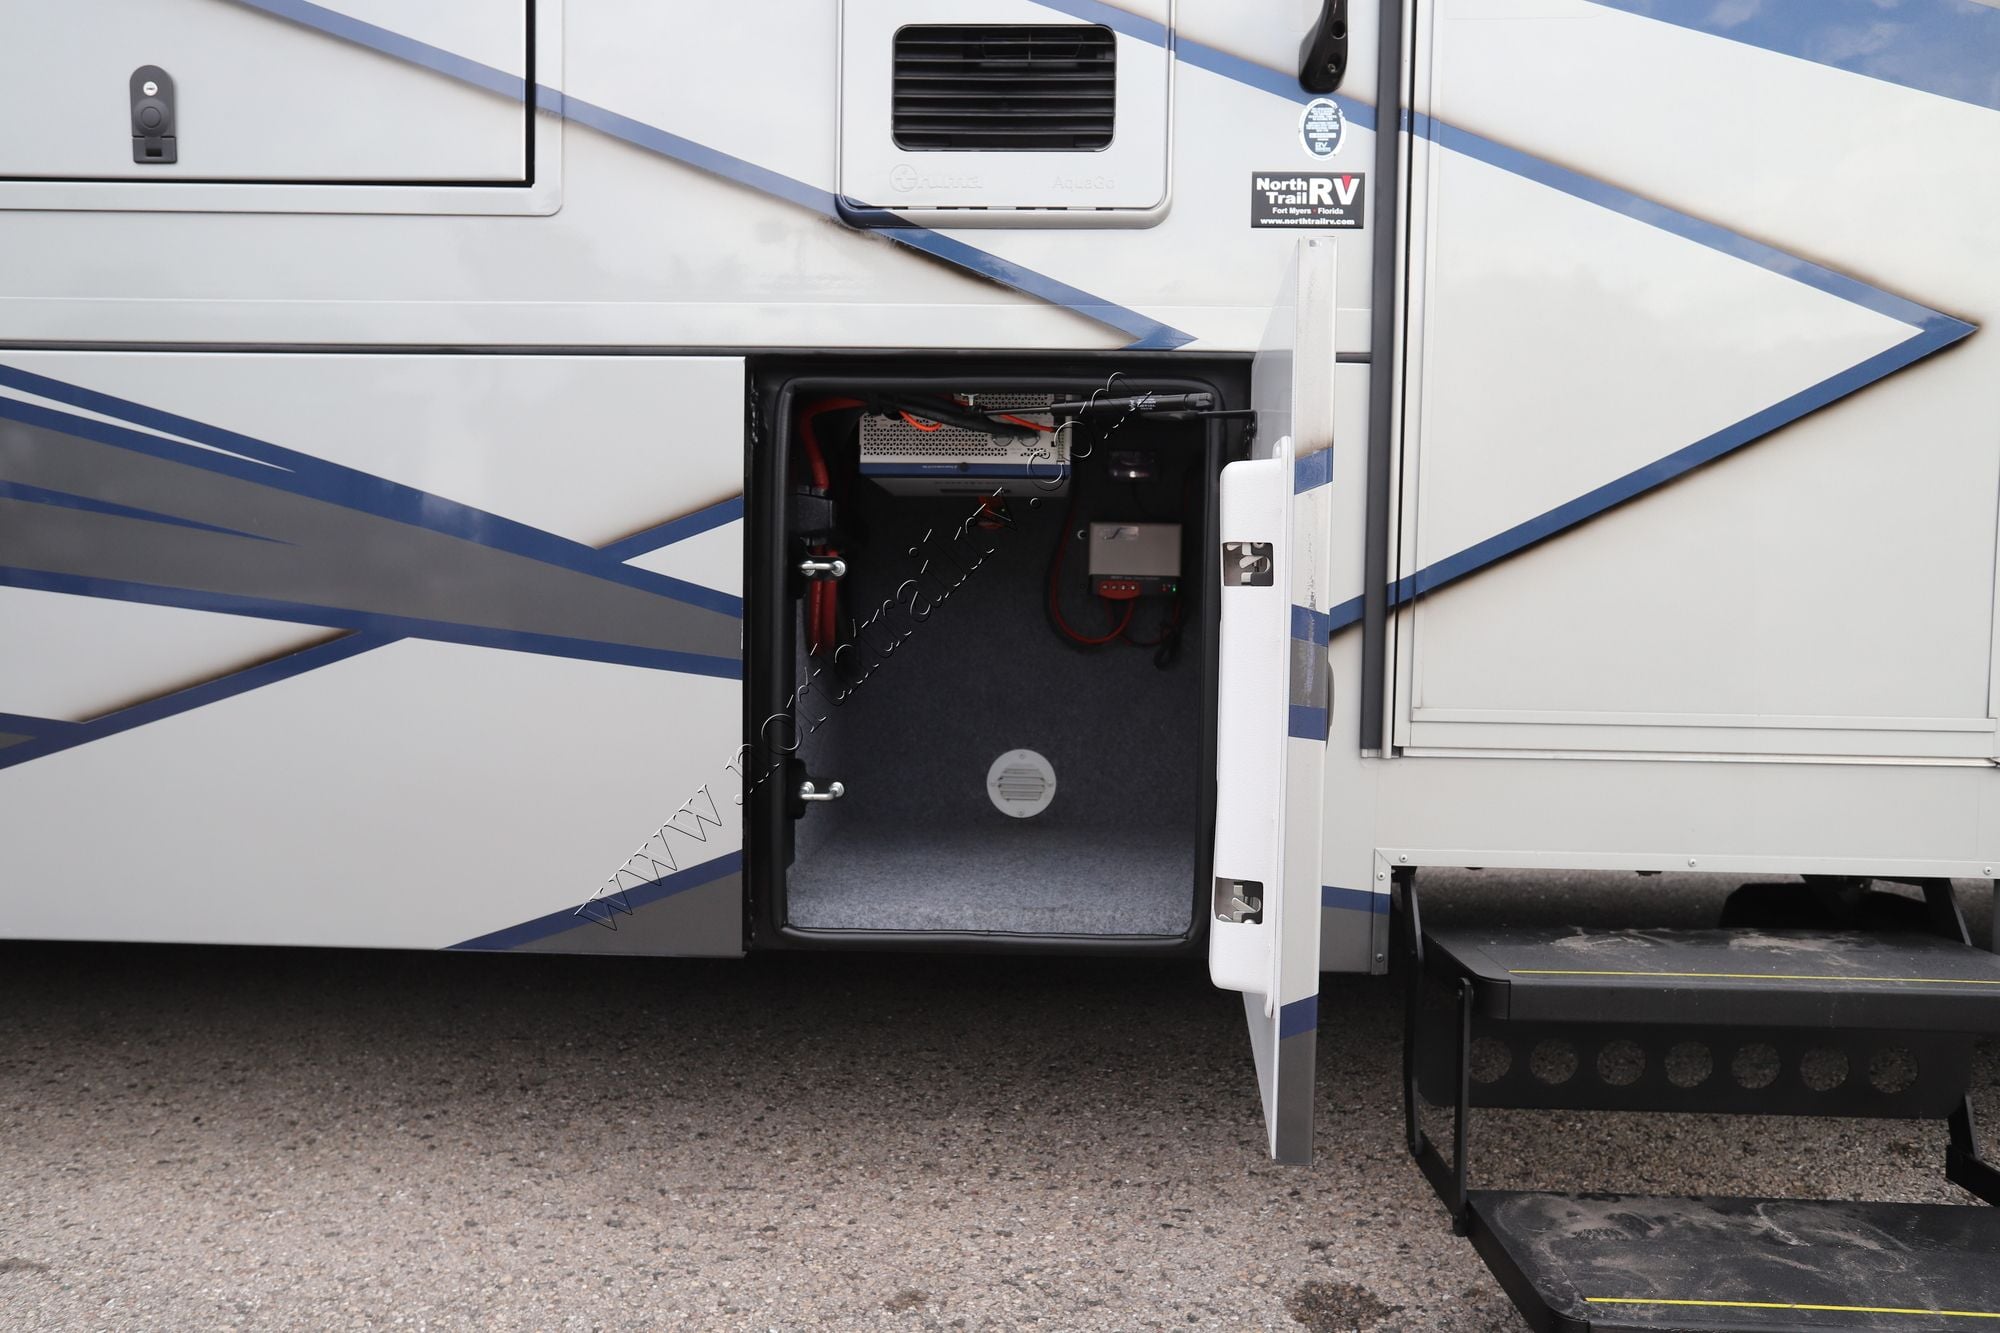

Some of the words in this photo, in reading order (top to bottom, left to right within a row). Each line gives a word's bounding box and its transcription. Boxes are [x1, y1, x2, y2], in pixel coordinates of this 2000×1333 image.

[1256, 177, 1307, 191] North
[1308, 177, 1360, 206] RV
[1265, 191, 1307, 205] Trail
[1272, 207, 1288, 215] Fort
[1289, 207, 1311, 217] Myers
[1317, 207, 1344, 215] Florida
[1260, 217, 1355, 226] www.northtrailrv.com
